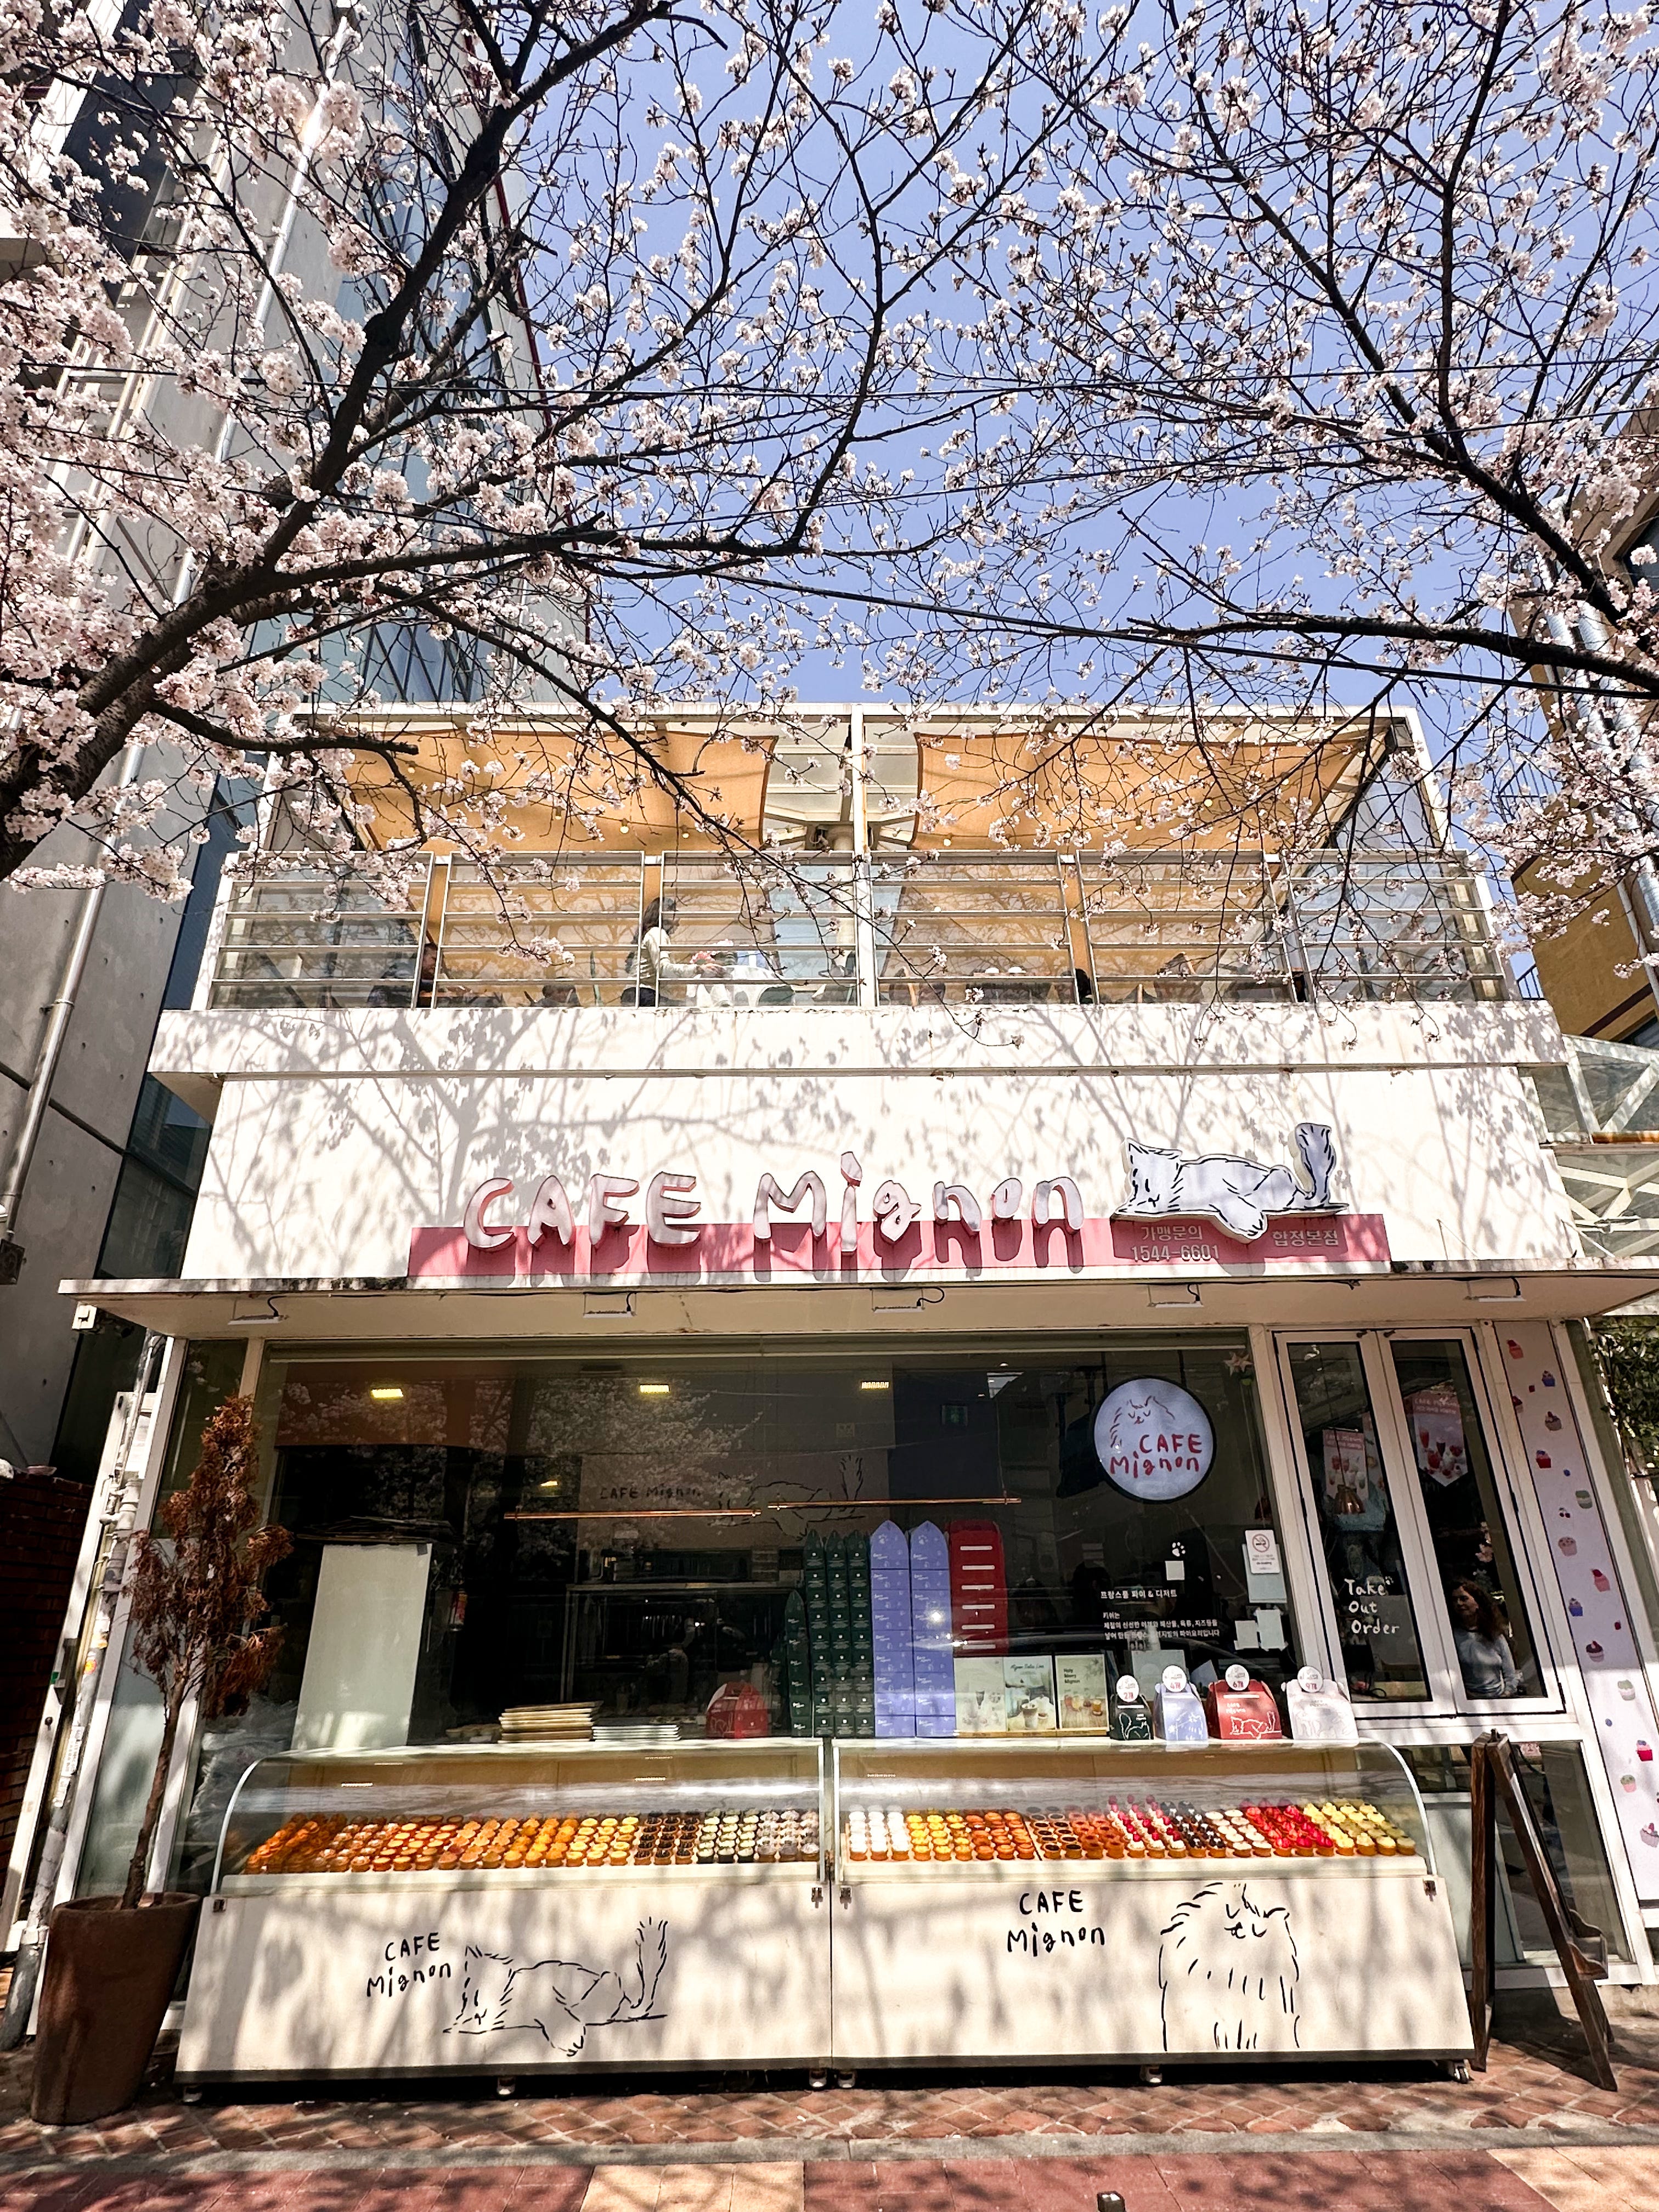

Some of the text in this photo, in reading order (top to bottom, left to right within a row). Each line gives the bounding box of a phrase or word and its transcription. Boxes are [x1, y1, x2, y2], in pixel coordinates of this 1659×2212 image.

[464, 1152, 1084, 1253] CAFE Mignon
[1141, 1225, 1203, 1242] 가맹문의
[1272, 1230, 1339, 1246] 합정본점
[1131, 1244, 1220, 1262] 1544-6601
[1139, 1434, 1203, 1454] CAFE
[1109, 1451, 1199, 1479] Mignon
[1155, 1589, 1177, 1598] 디저트
[1344, 1578, 1386, 1596] Take
[1348, 1600, 1378, 1614] Out
[1351, 1618, 1400, 1634] Order
[1019, 1890, 1084, 1915] CAFE
[385, 1932, 441, 1962] CAFE
[1007, 1922, 1105, 1957] Mignon
[366, 1962, 452, 1997] Mignon
